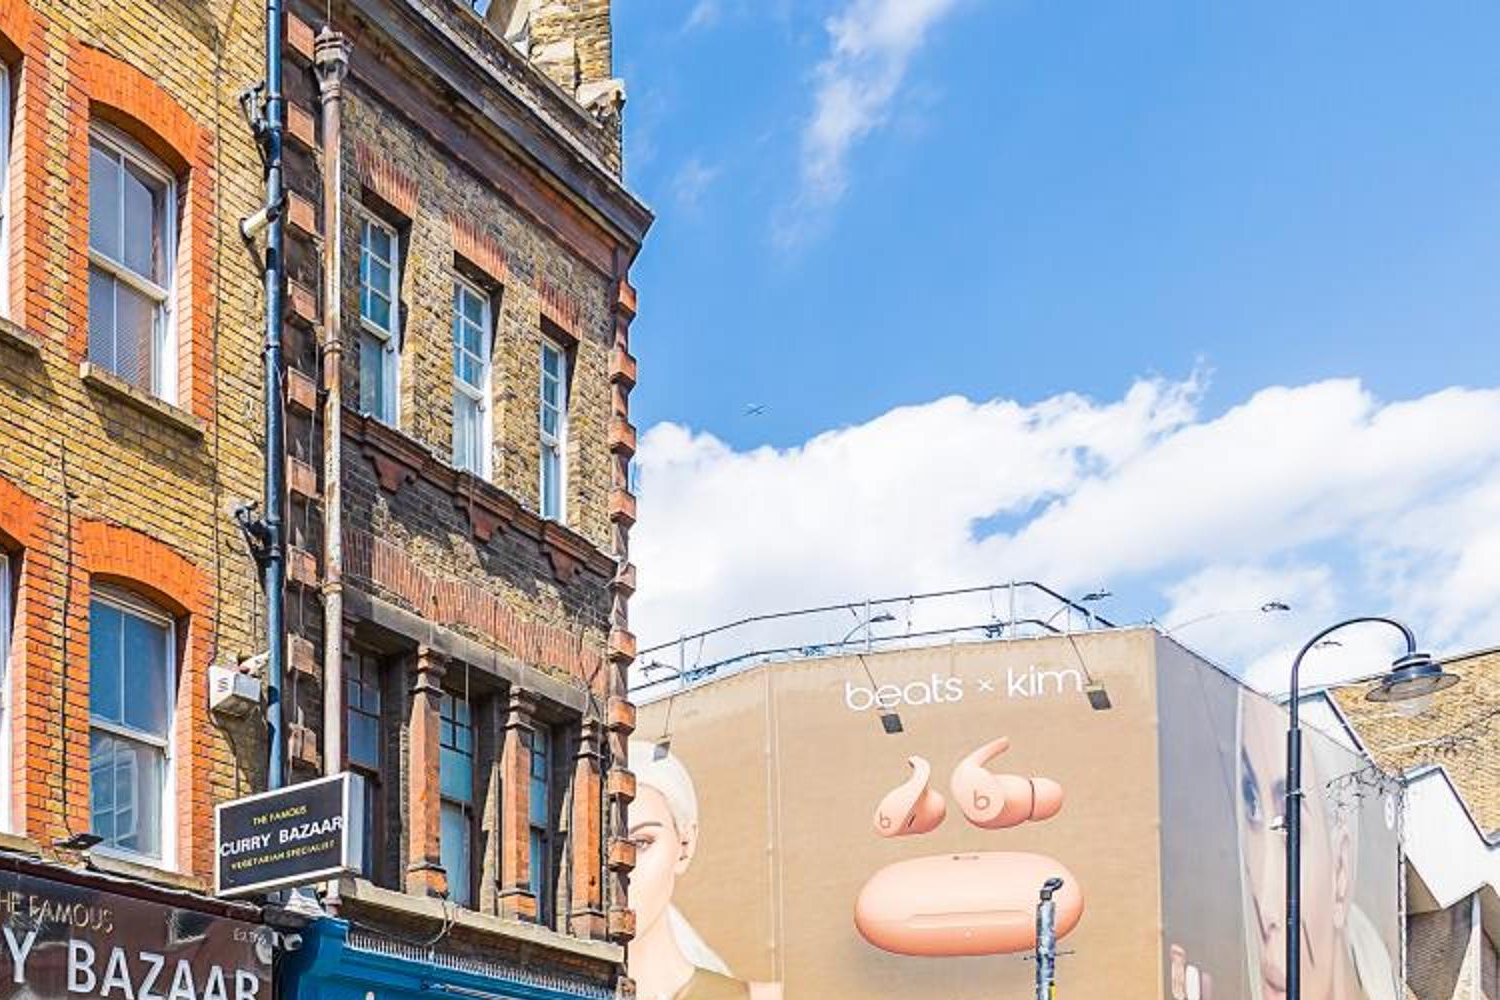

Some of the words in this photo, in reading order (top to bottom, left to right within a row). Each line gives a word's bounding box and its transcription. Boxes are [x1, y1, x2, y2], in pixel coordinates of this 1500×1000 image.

[845, 672, 963, 712] beats
[1006, 664, 1084, 698] kim
[220, 832, 271, 858] CURRY
[279, 814, 344, 844] BAZAAR
[253, 812, 269, 827] THE
[28, 894, 114, 934] FAMOUS
